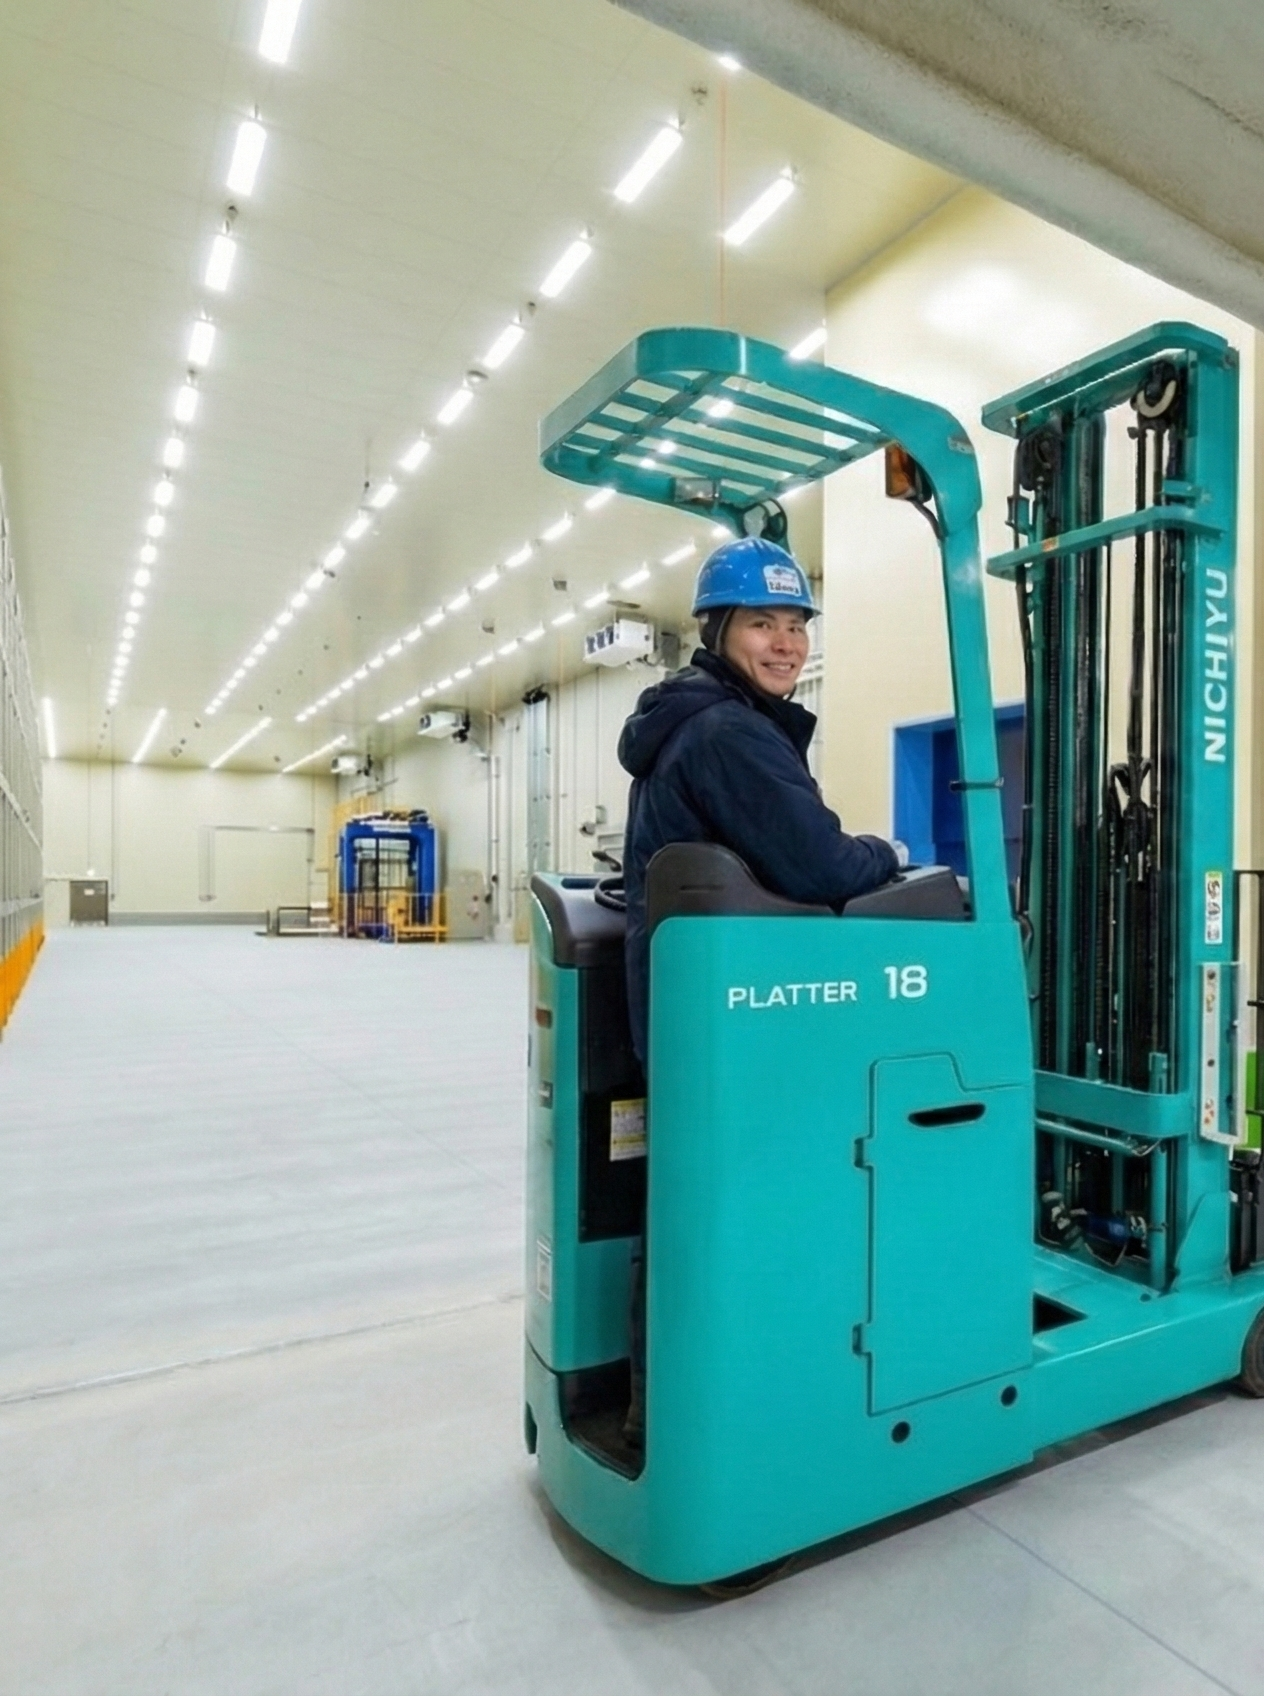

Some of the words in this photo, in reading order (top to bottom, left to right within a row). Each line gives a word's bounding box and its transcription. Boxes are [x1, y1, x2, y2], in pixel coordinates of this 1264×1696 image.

[1204, 568, 1228, 763] NICHIYU
[728, 981, 857, 1009] PLATTER
[884, 965, 928, 999] 18
